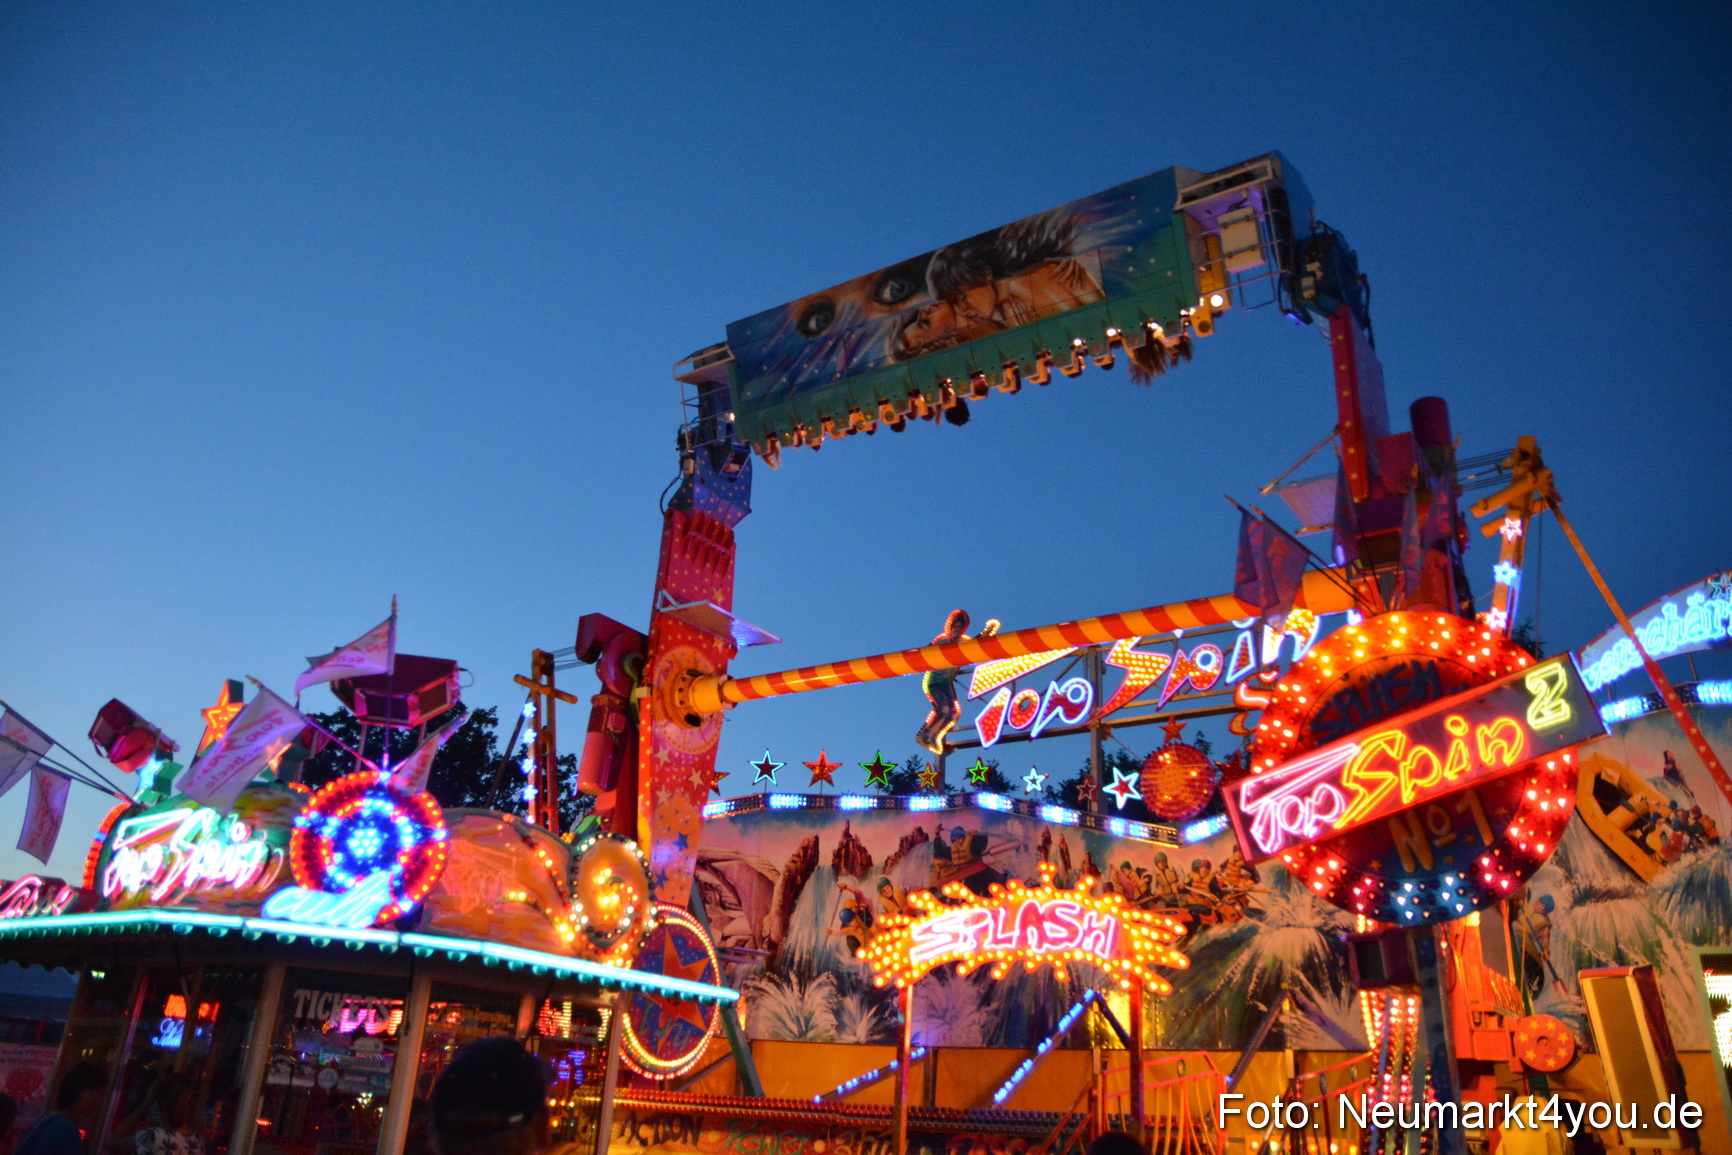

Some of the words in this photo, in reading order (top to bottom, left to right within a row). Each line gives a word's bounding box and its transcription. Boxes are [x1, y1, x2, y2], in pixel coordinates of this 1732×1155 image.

[968, 644, 1094, 749] Top
[1240, 742, 1361, 854] Top
[1333, 715, 1525, 829] Spin
[1524, 662, 1571, 731] 2
[1457, 789, 1495, 847] 1
[909, 900, 1116, 966] SPLASH
[293, 988, 393, 1023] TICKETS
